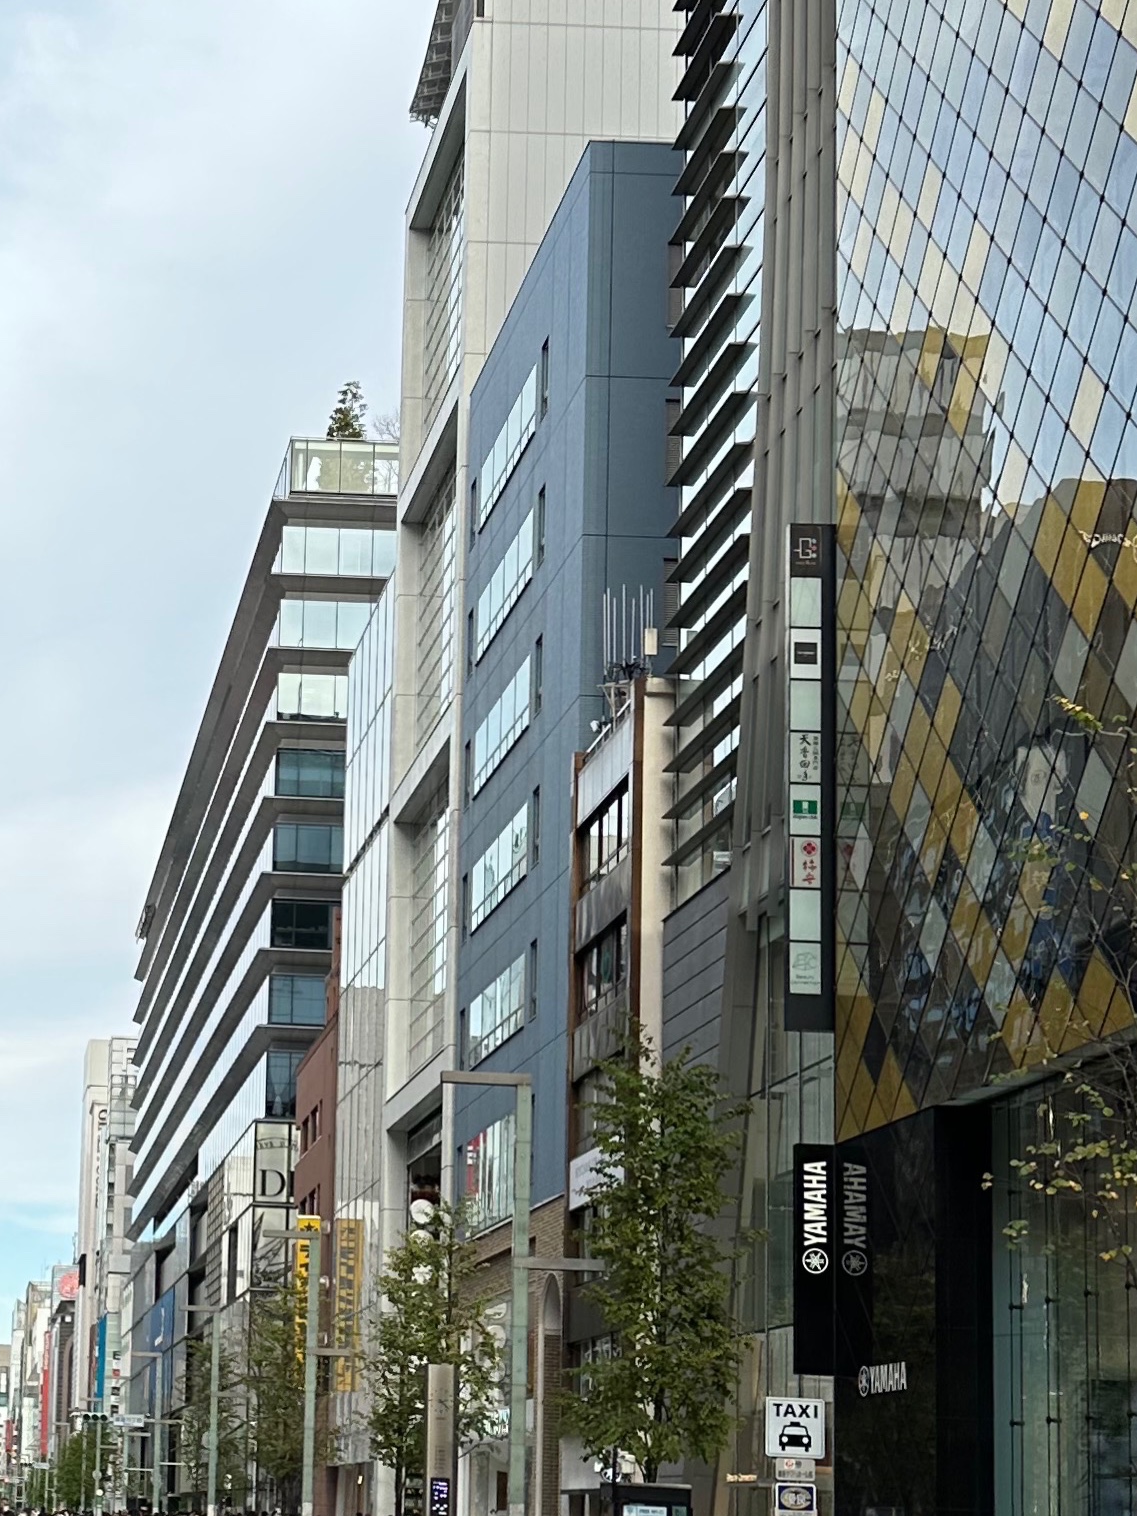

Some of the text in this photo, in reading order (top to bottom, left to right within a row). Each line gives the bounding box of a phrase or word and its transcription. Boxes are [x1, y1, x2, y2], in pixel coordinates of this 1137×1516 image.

[803, 1161, 827, 1246] YAMAHA
[869, 1361, 908, 1395] YAMAHA
[772, 1402, 819, 1420] TAXI
